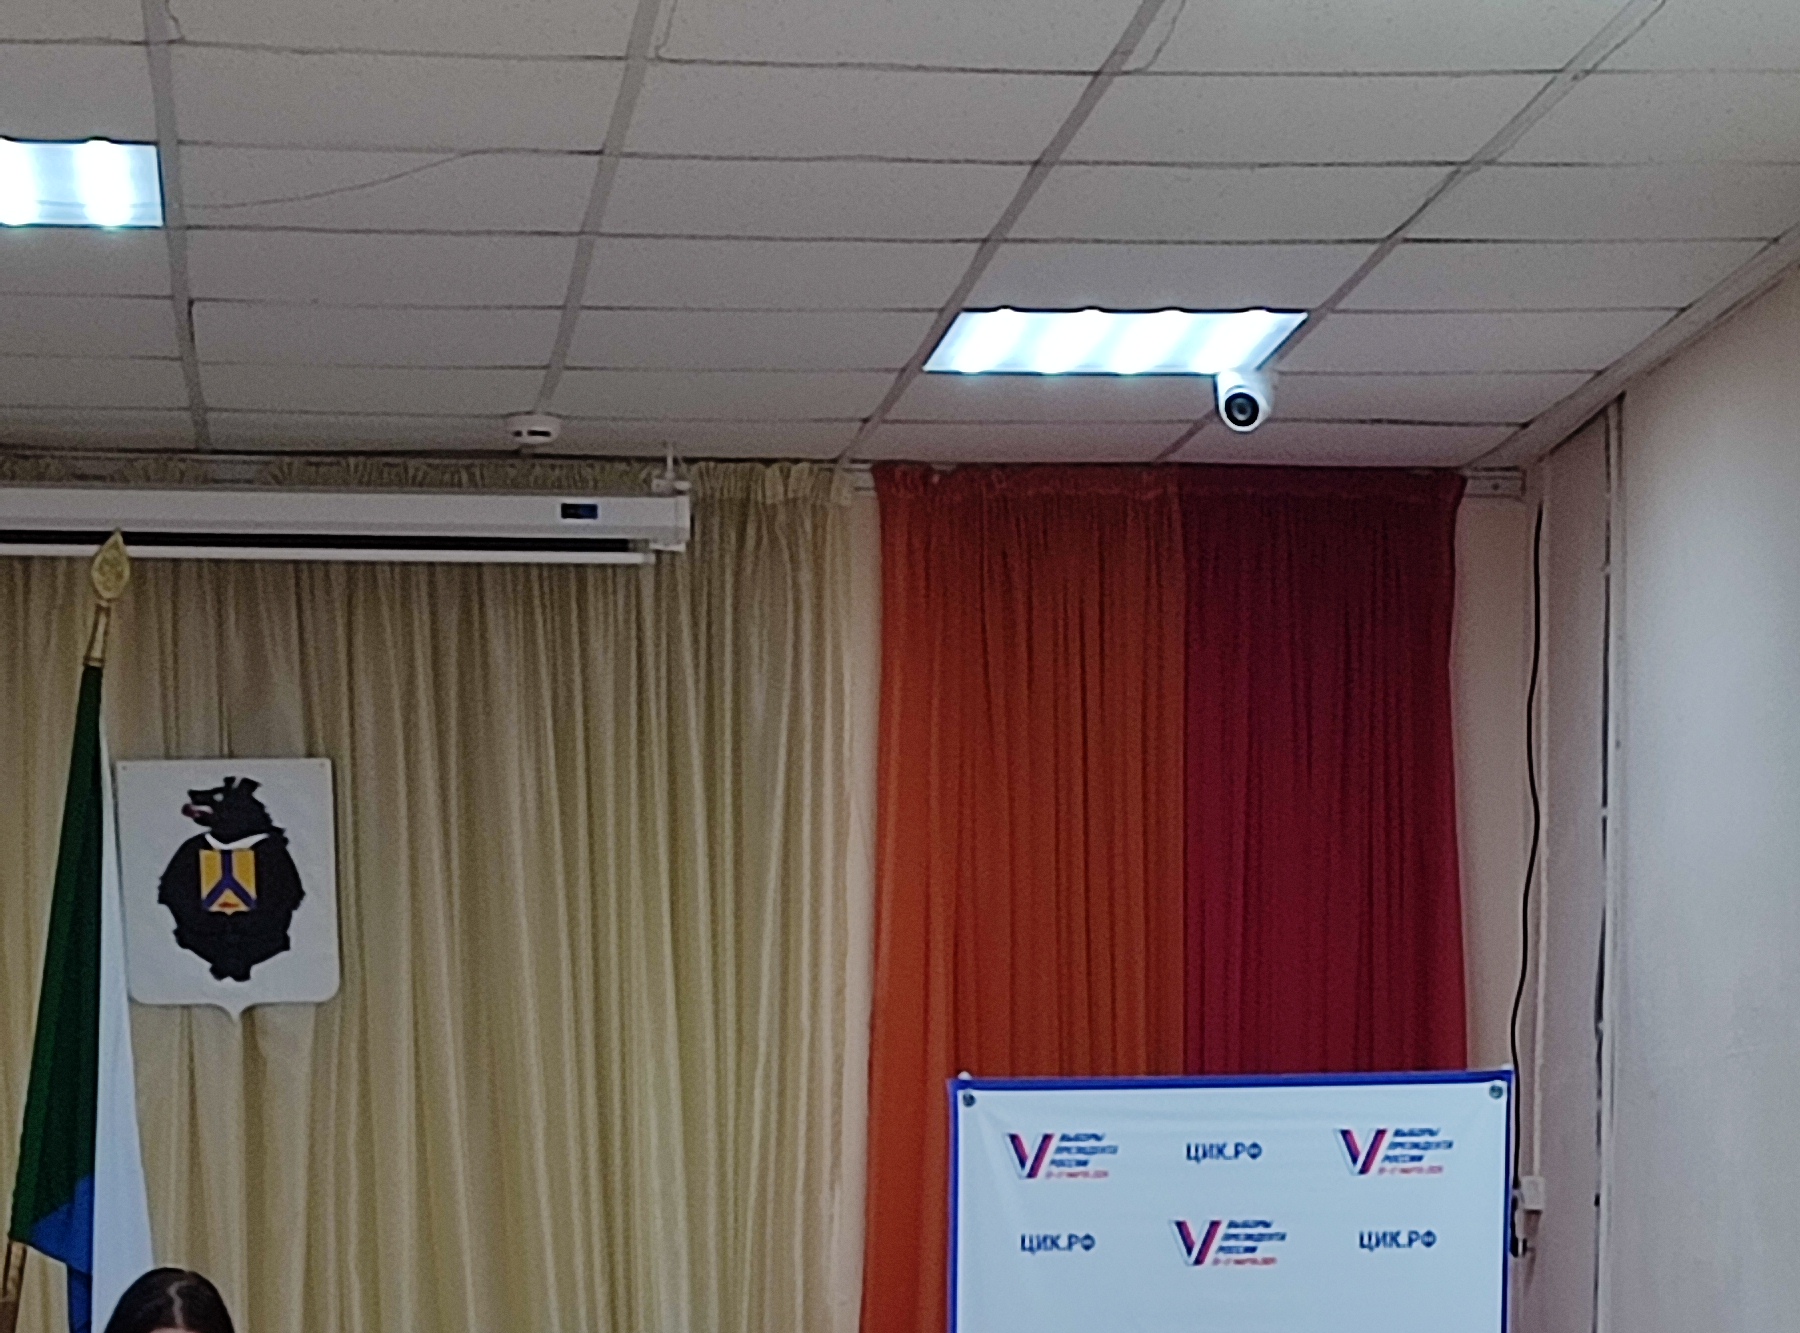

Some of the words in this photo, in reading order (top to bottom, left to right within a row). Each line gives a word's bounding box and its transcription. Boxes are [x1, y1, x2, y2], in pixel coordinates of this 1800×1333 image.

[1186, 1142, 1263, 1161] ЦИК.РФ
[1020, 1233, 1096, 1253] ЦИК.РФ
[1359, 1230, 1437, 1250] ЦИК.РФ
